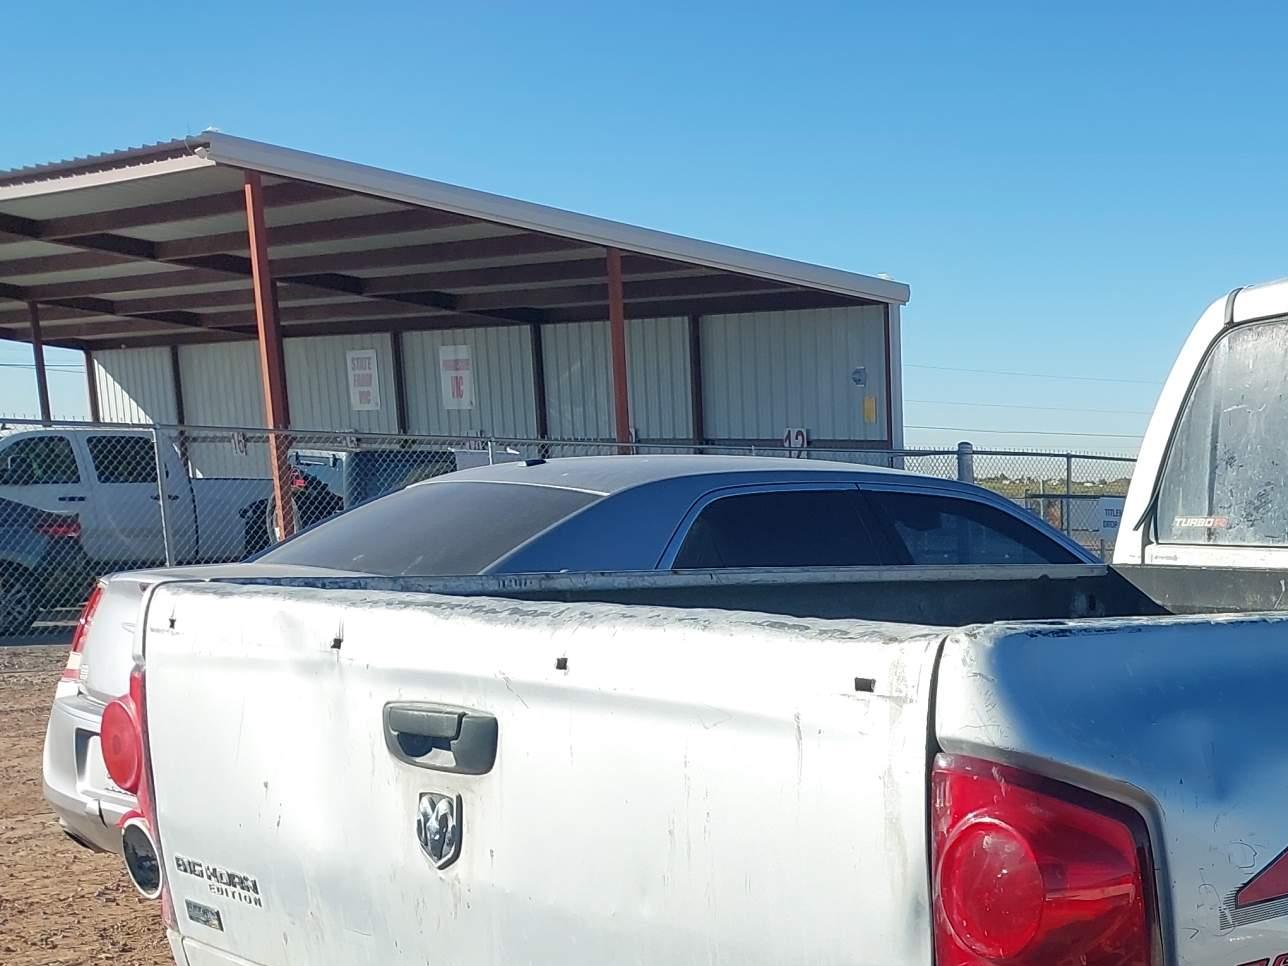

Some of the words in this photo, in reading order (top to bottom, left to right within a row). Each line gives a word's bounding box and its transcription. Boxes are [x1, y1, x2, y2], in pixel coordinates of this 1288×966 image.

[174, 854, 205, 880] BIG
[204, 864, 261, 896] HORN
[208, 882, 263, 909] EDITION
